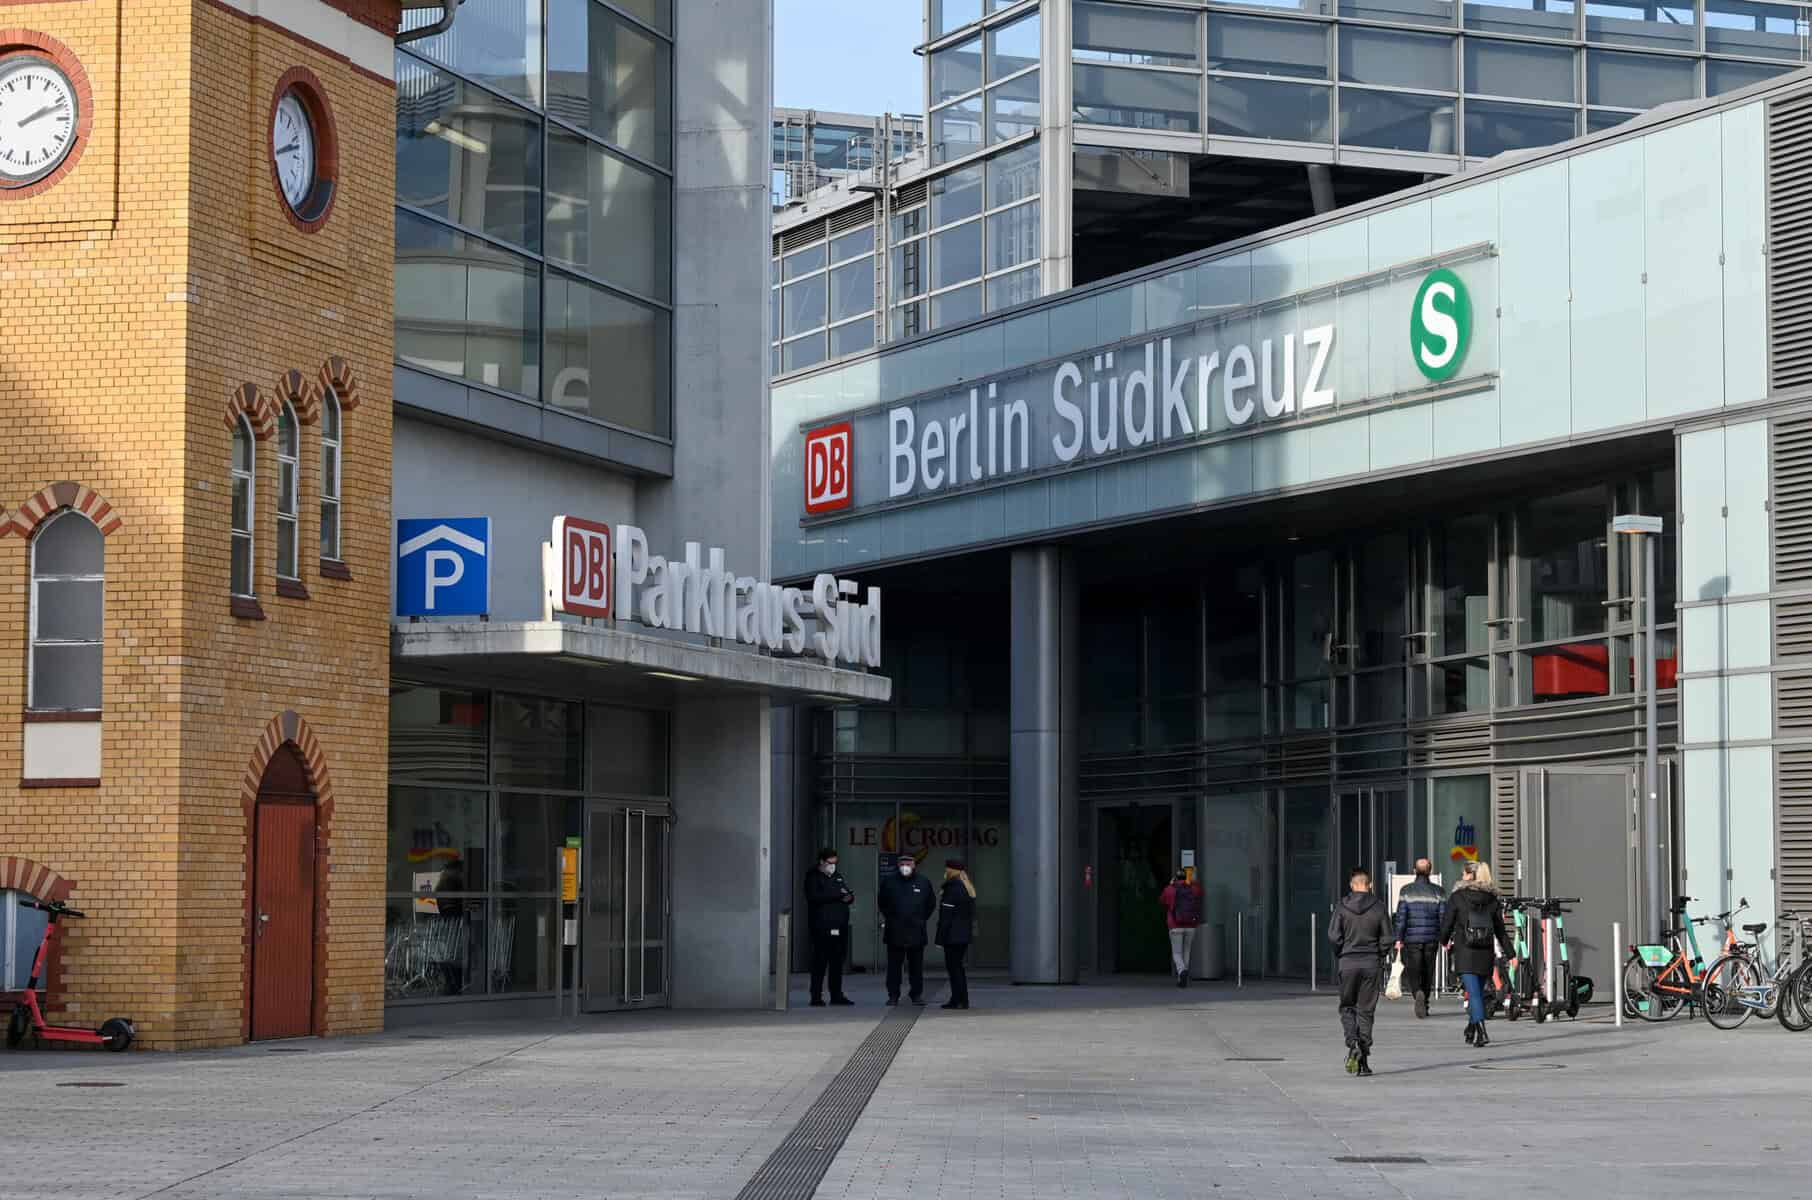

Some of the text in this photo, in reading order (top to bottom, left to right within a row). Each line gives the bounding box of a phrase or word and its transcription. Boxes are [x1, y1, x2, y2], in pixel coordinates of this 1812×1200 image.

[1421, 282, 1458, 368] S
[811, 324, 1335, 500] DB Berlin Südkreuz
[425, 550, 464, 609] P
[569, 524, 881, 667] DB Parkhaus Süd
[850, 827, 877, 846] LE
[1455, 816, 1473, 846] dm
